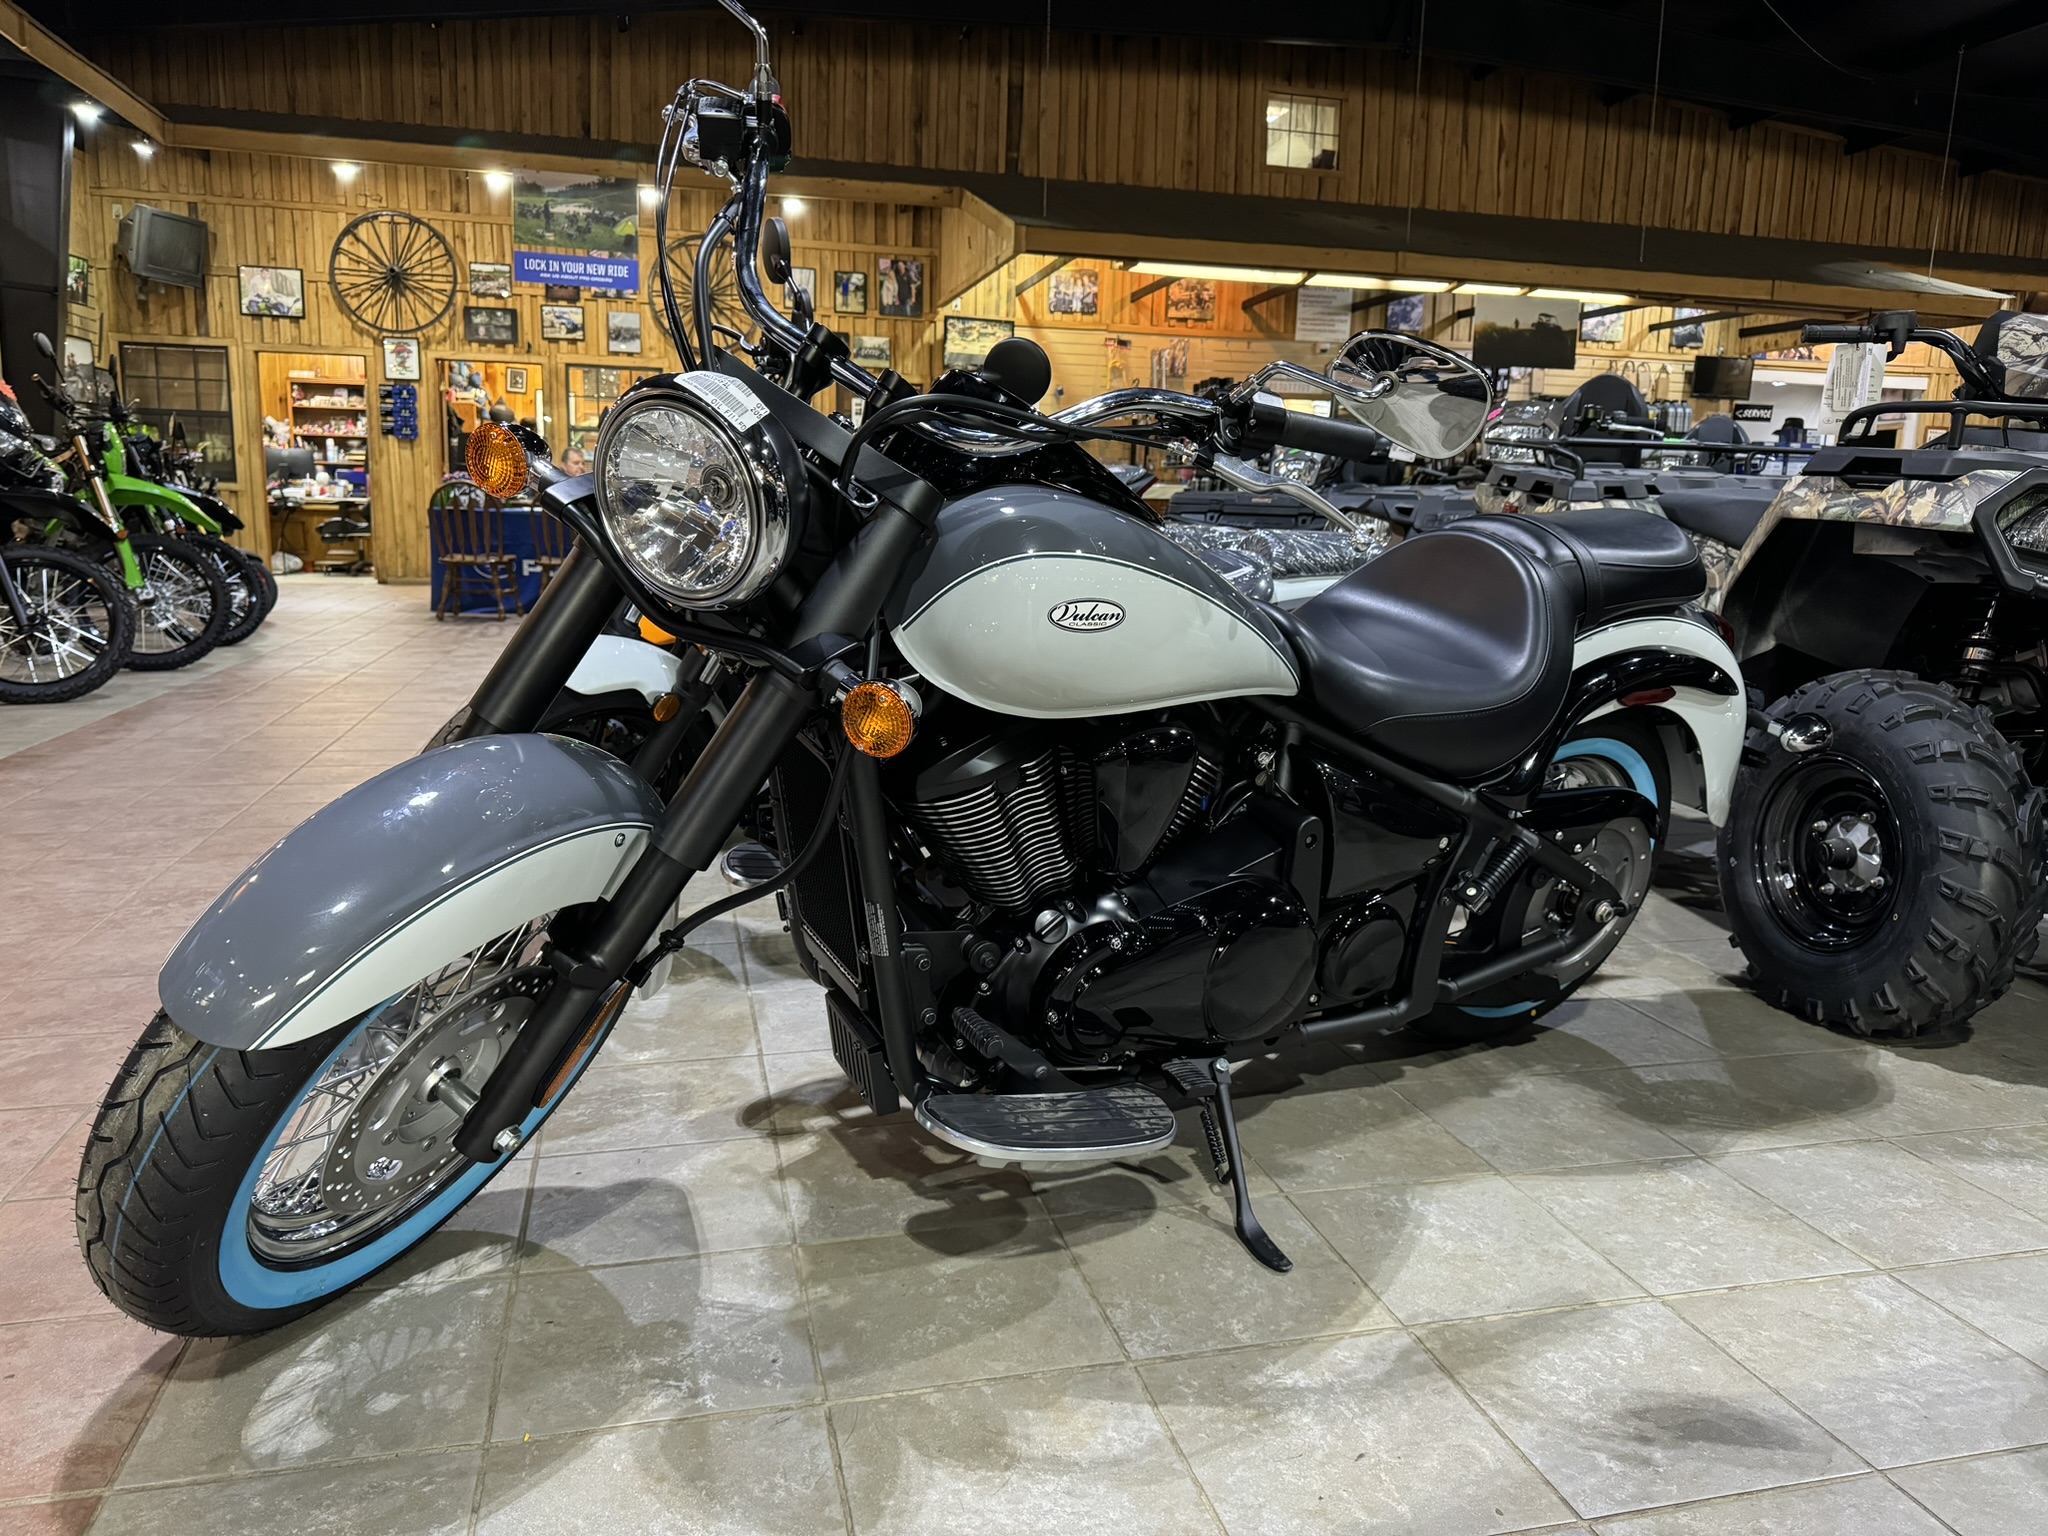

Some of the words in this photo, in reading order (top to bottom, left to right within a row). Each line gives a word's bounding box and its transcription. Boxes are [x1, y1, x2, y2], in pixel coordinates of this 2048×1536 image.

[524, 258, 547, 271] LOCK
[549, 260, 560, 272] IN
[561, 261, 585, 274] YOUR
[586, 263, 606, 276] NEW
[607, 264, 629, 278] RIDE
[710, 398, 721, 409] OIL
[1056, 603, 1121, 622] Vulcan
